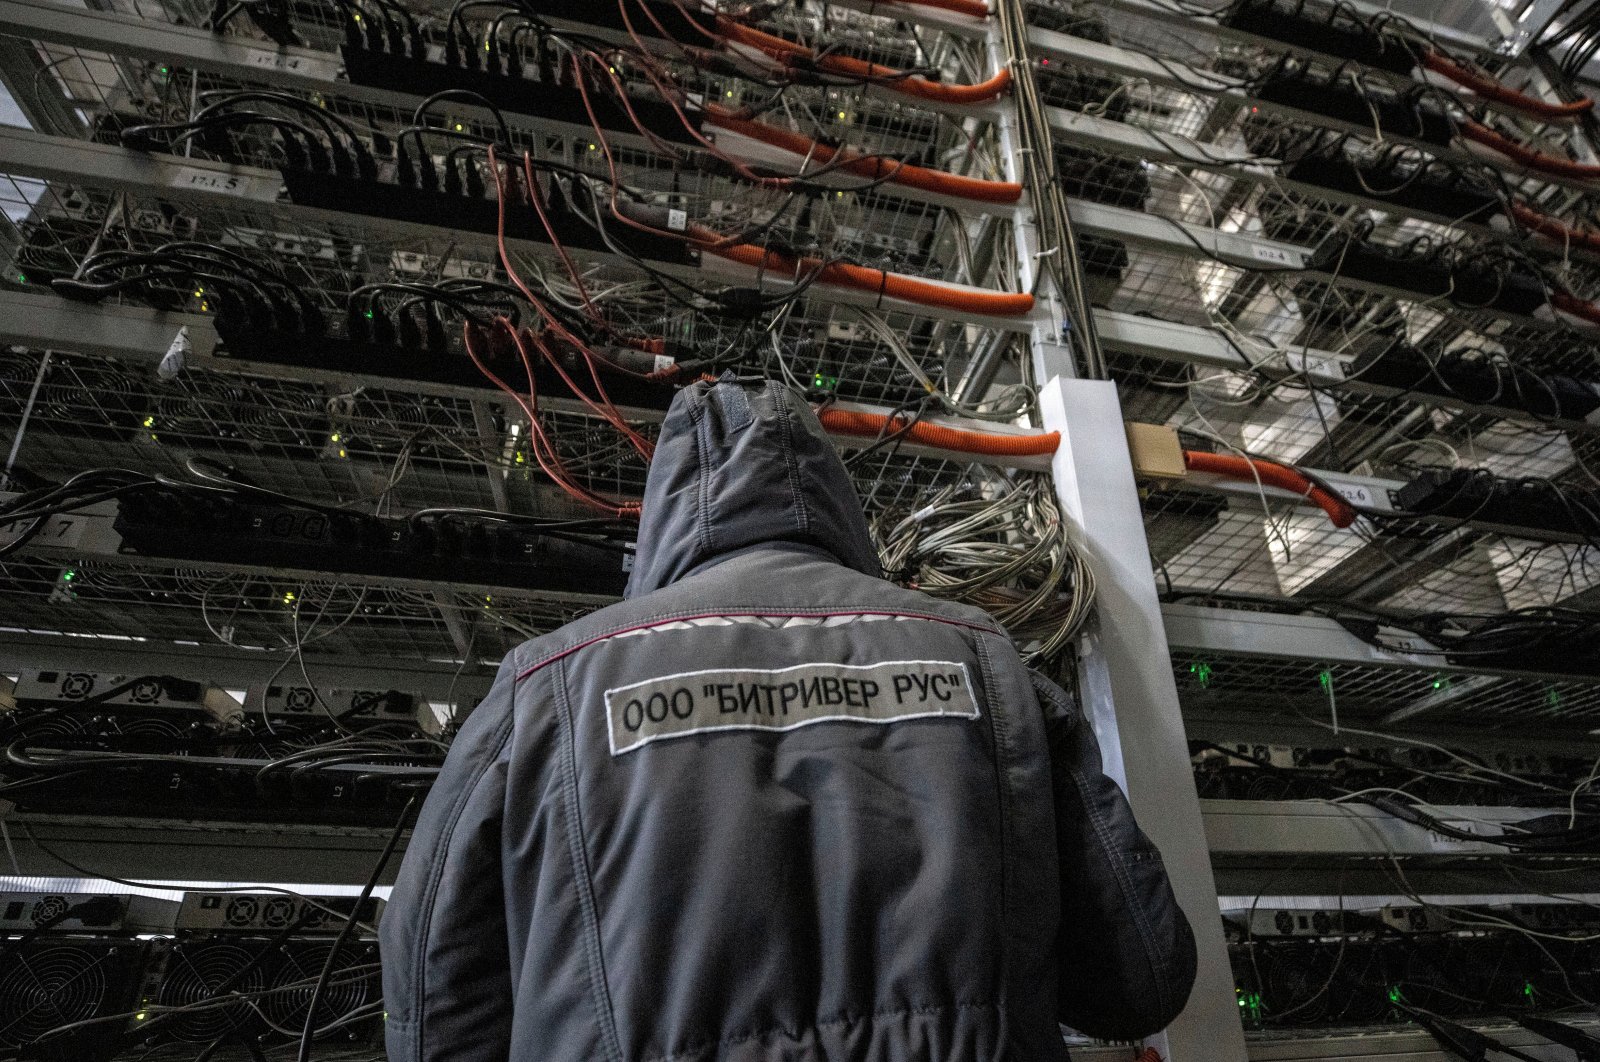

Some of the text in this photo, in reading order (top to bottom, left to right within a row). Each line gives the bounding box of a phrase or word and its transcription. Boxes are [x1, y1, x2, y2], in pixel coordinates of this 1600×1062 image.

[191, 175, 238, 190] 17.1.5
[252, 518, 262, 527] L3
[391, 531, 401, 541] L2
[523, 543, 533, 553] L1
[622, 672, 959, 732] ООО "БИТРИВЕР РУС"
[332, 785, 343, 797] L2
